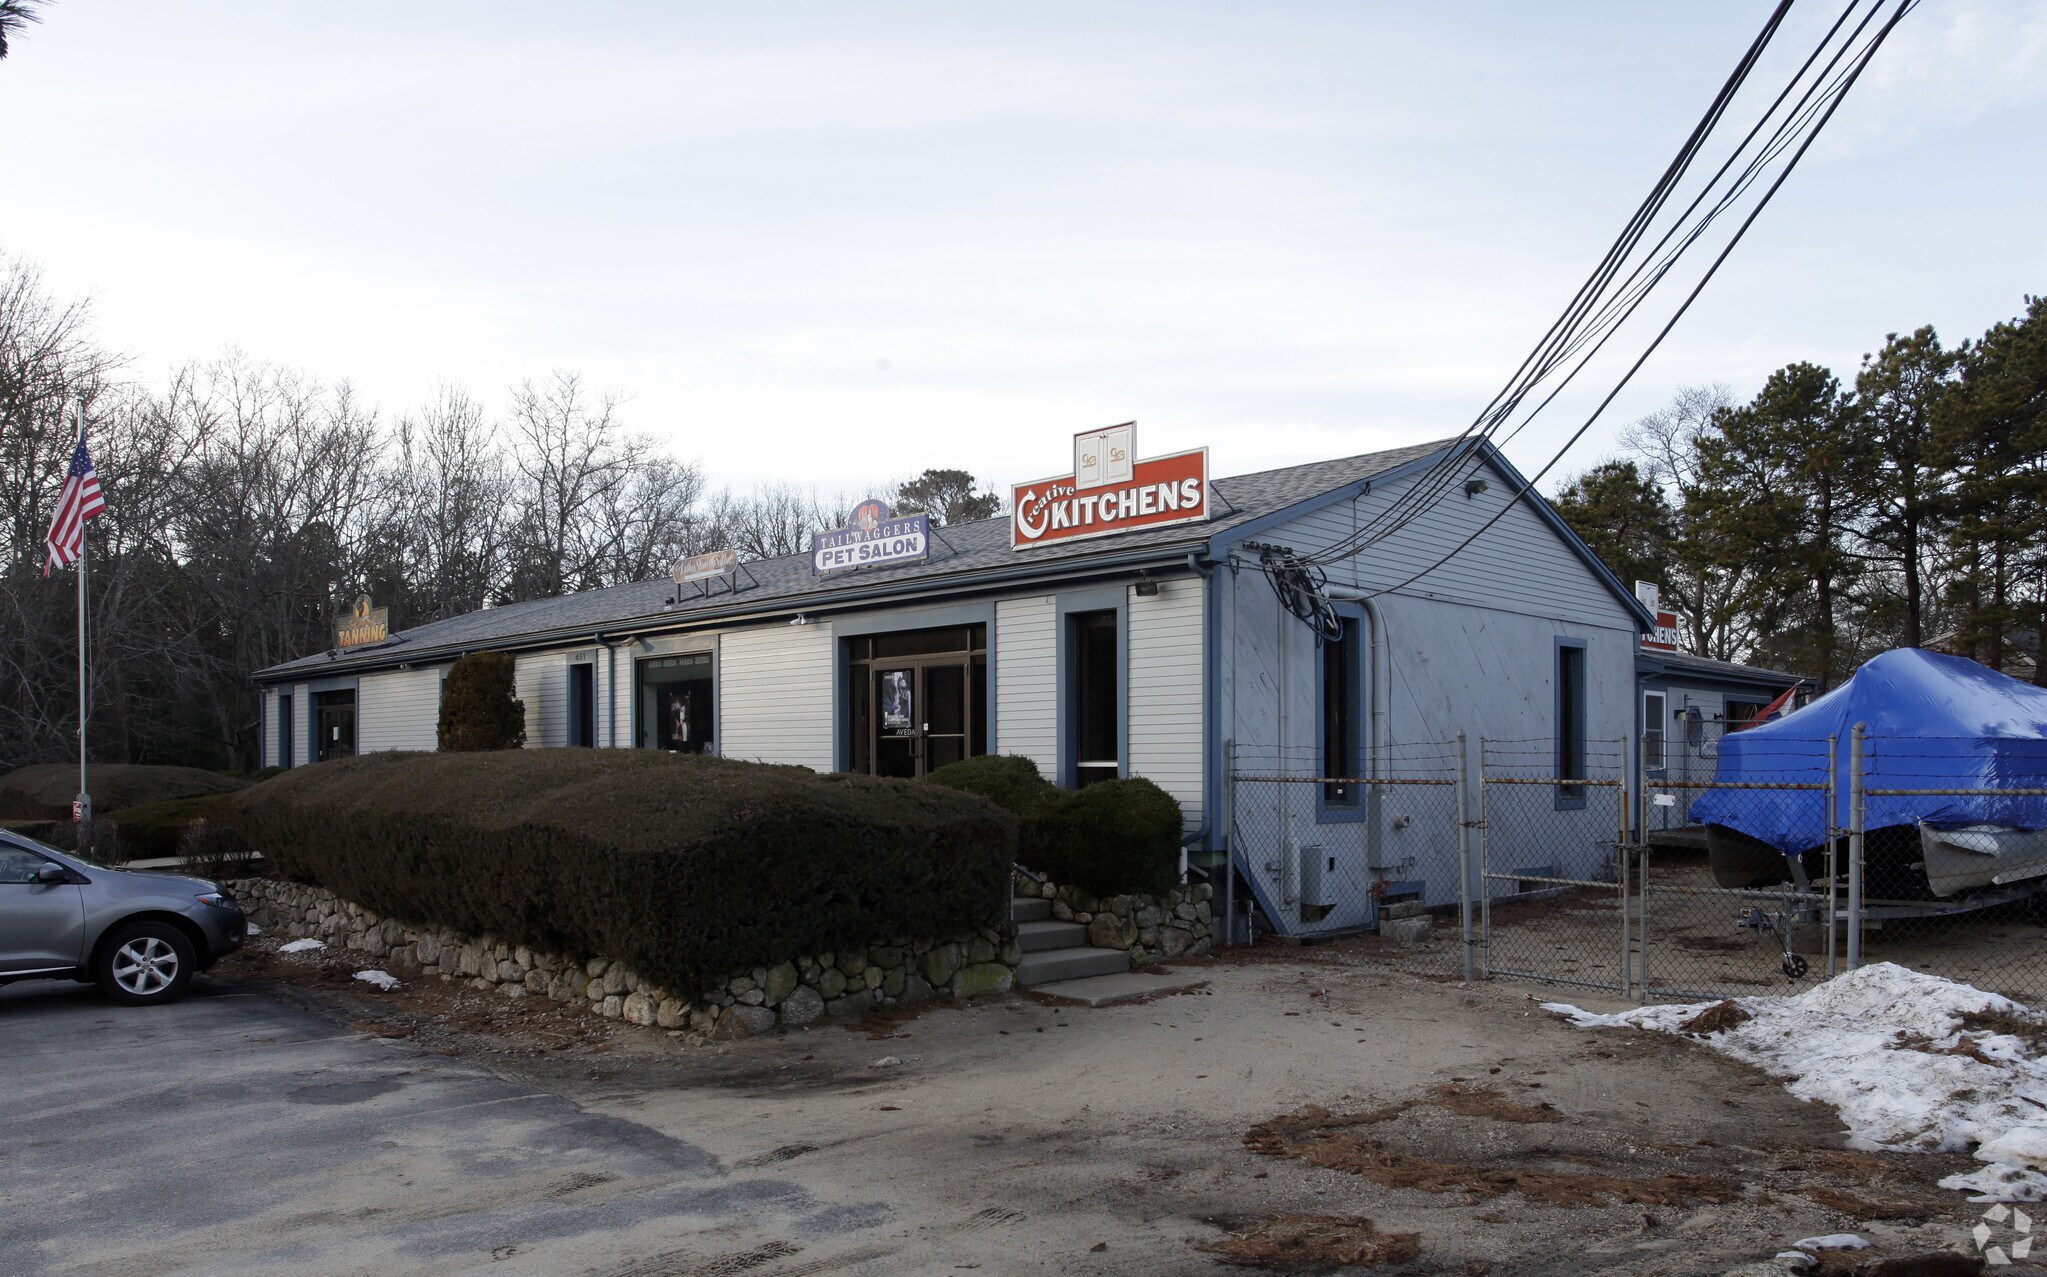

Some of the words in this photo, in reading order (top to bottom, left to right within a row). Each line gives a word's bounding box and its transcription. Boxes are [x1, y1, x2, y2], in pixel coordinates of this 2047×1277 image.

[1017, 484, 1075, 539] Creative
[1051, 478, 1201, 530] KITCHENS
[822, 547, 855, 567] PET
[859, 537, 918, 560] SALON
[338, 623, 386, 647] TANNING
[896, 728, 916, 736] AVEDA
